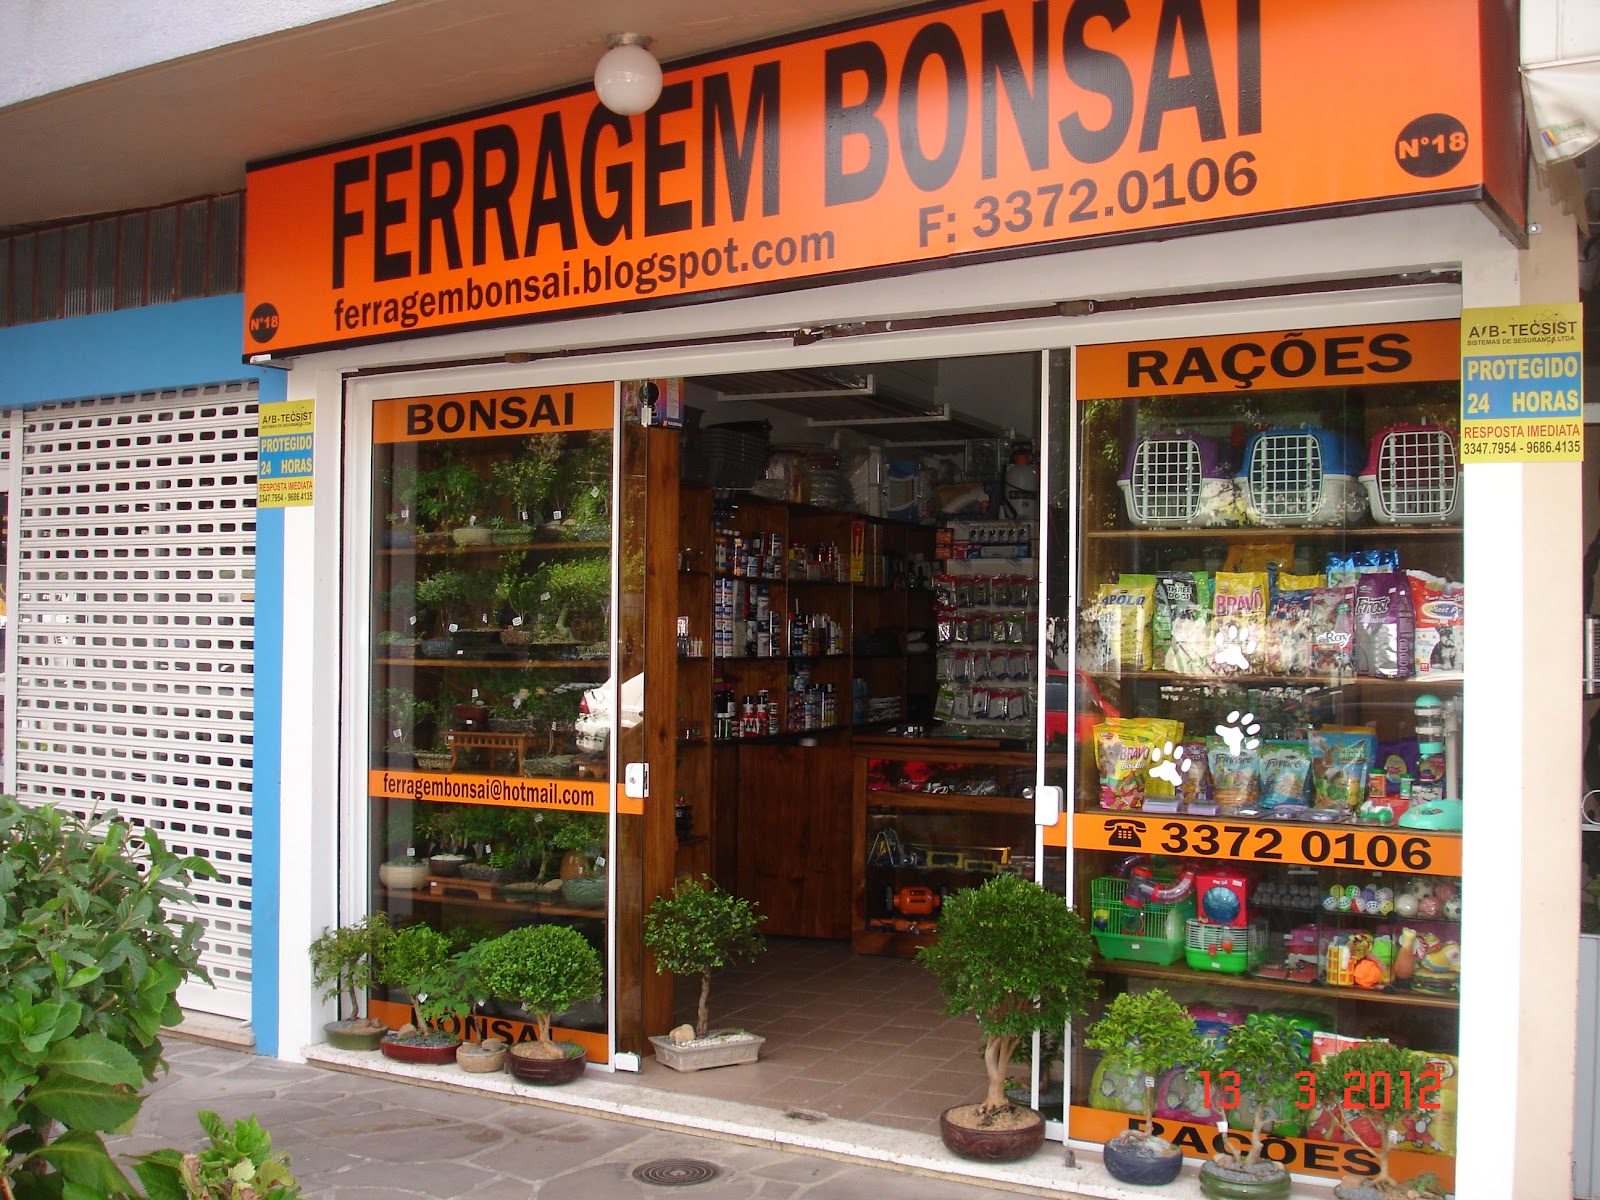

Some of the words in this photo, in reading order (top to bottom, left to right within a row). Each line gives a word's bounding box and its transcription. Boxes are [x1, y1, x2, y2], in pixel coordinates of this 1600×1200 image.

[332, 60, 781, 290] FERRAGEM
[824, 0, 1262, 208] BONSAI
[918, 204, 956, 247] F:
[973, 150, 1257, 238] 3372.0106
[334, 229, 835, 332] ferragembonsai.blogspot.com
[1514, 336, 1556, 345] SEGURANÇA
[1127, 330, 1412, 389] RAÇÕES
[1468, 356, 1578, 381] PROTEGIDO
[407, 392, 575, 436] BONSAI
[1467, 392, 1490, 414] 24
[1512, 390, 1579, 413] HORAS
[1464, 425, 1524, 439] RESPOSTA
[1527, 424, 1580, 437] IMEDIATA
[261, 435, 312, 453] PROTEGIDO
[1464, 441, 1517, 455] 3347.7954
[1526, 440, 1581, 453] 9686.4135
[261, 461, 272, 475] 24
[281, 458, 313, 474] HORAS
[259, 482, 287, 492] RESPOSTA
[288, 481, 313, 491] IMEDIATA
[1101, 595, 1145, 605] APOLO
[1216, 591, 1263, 616] BRAVO
[1355, 597, 1390, 615] Frost
[1120, 746, 1150, 760] BRAVO
[383, 773, 594, 807] ferragembonsai@hotmail.com
[1161, 822, 1283, 860] 3372
[1300, 830, 1432, 871] 0106
